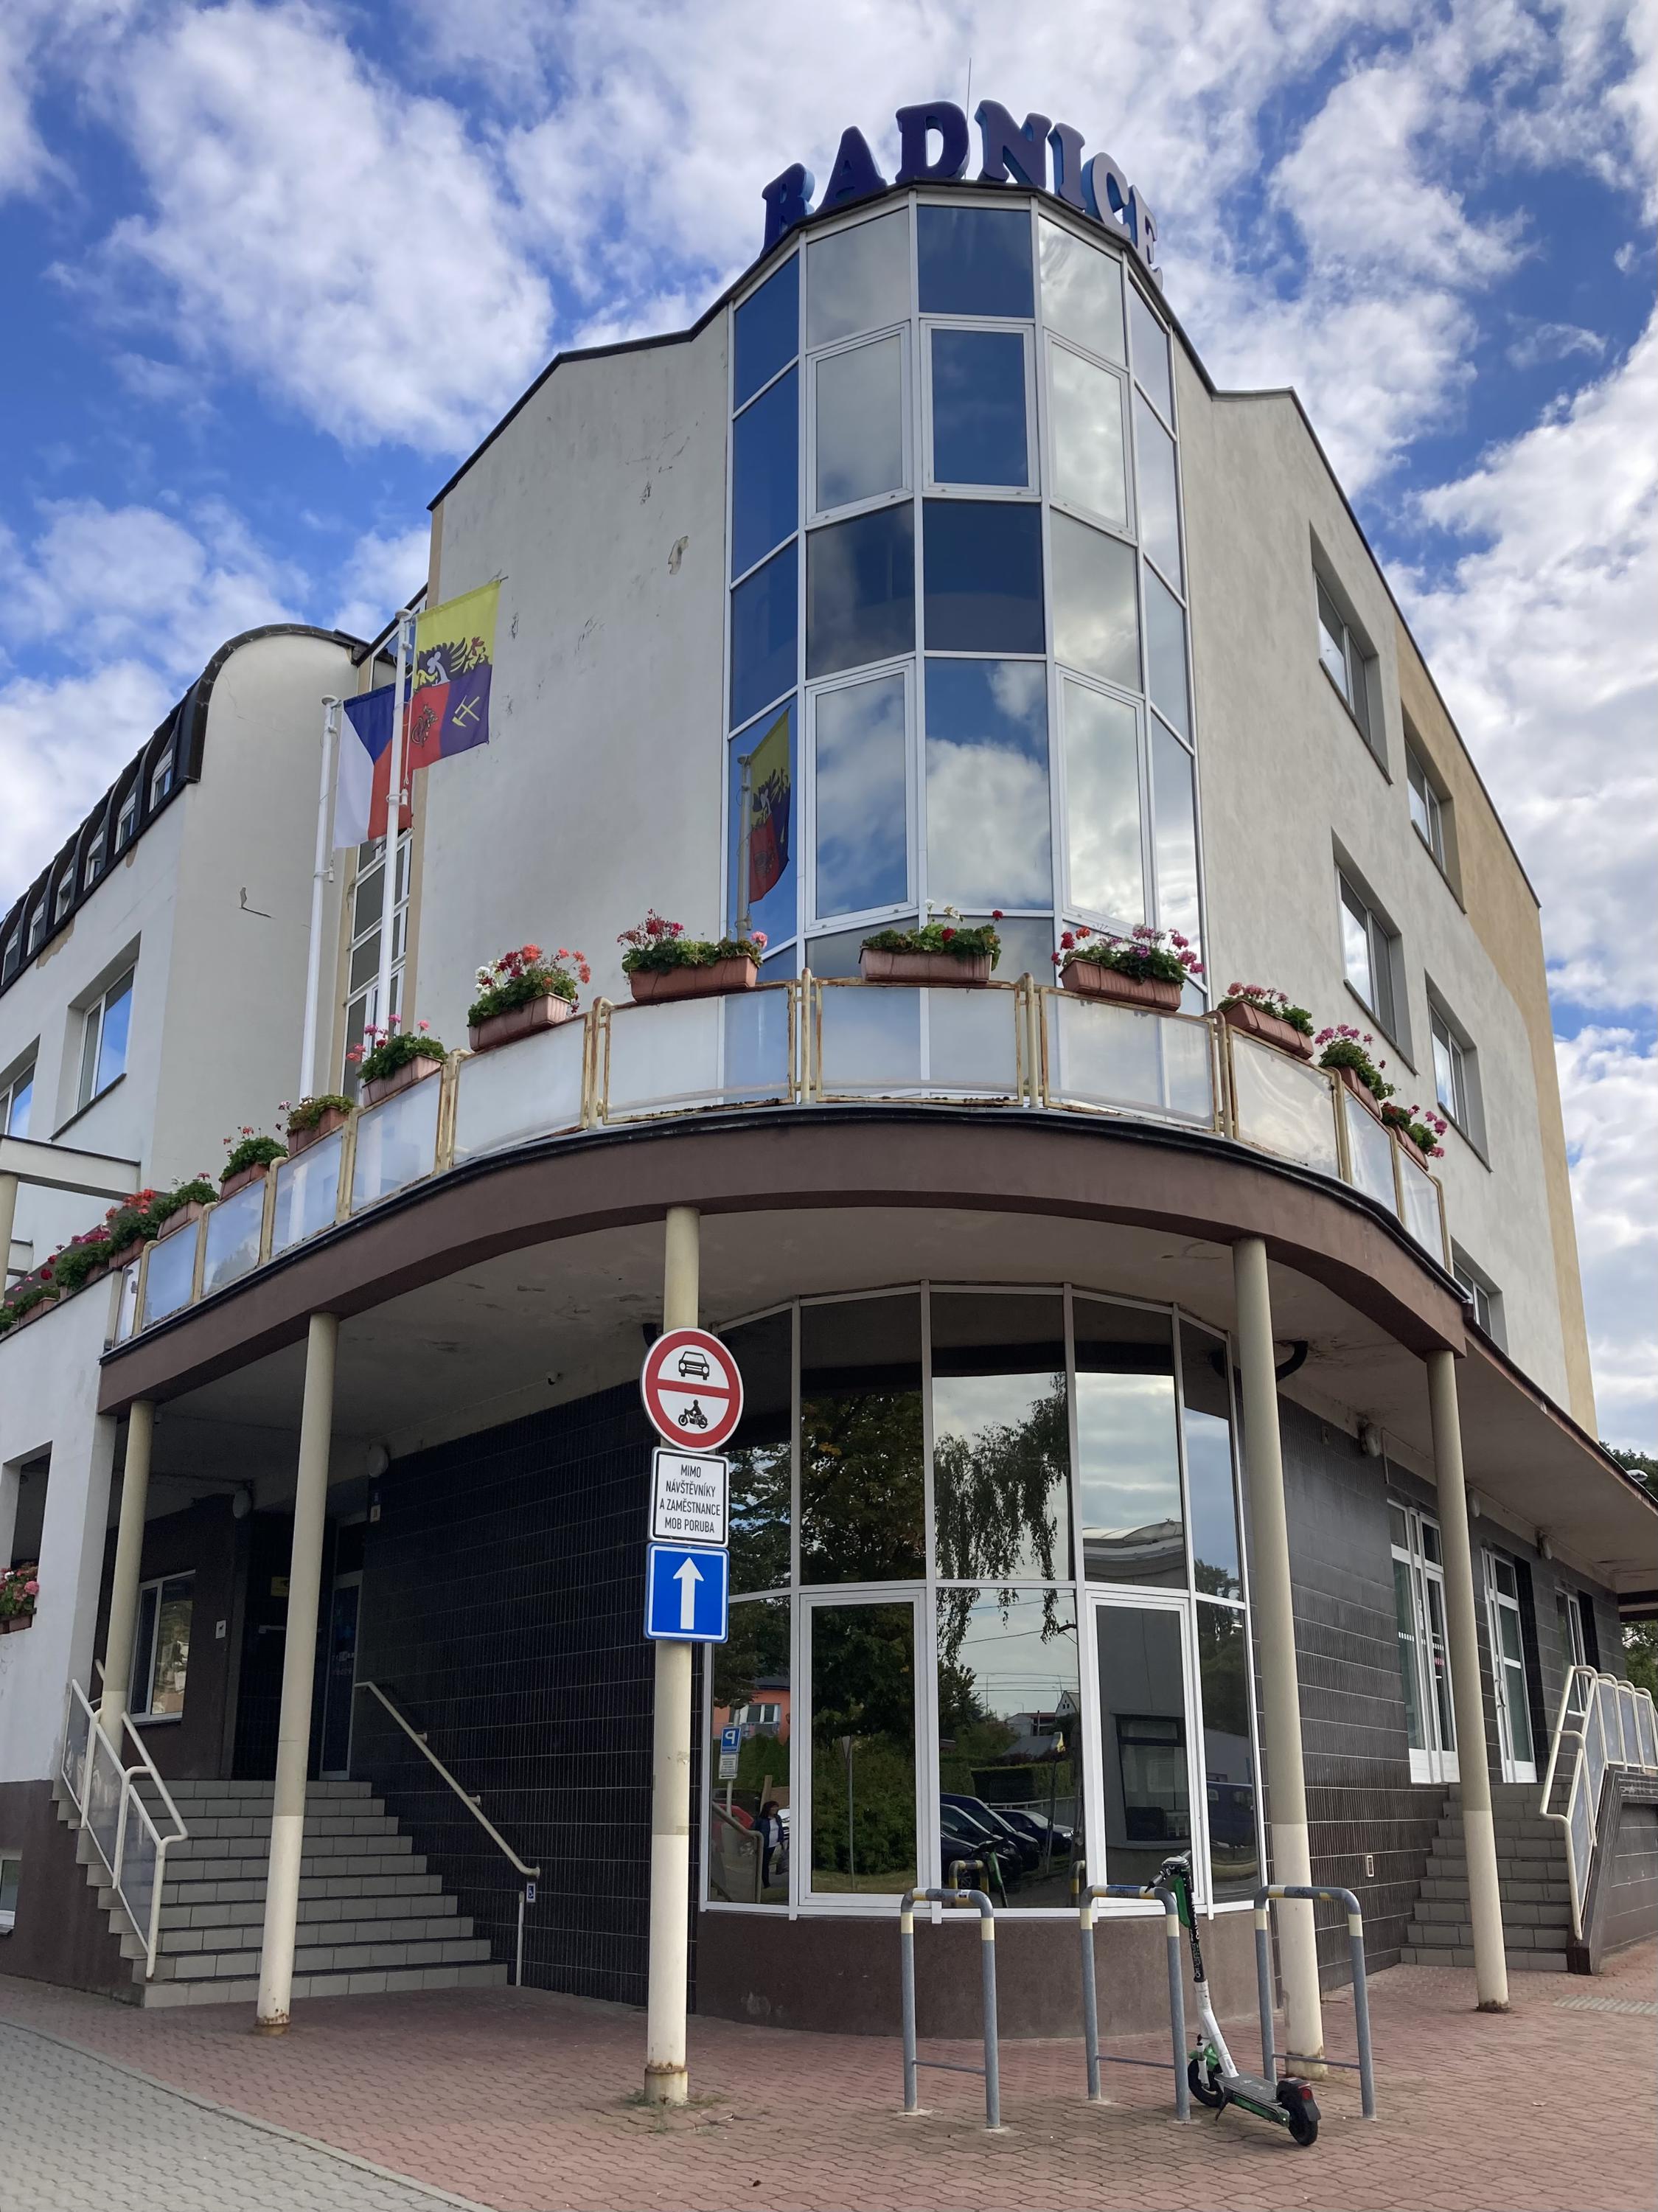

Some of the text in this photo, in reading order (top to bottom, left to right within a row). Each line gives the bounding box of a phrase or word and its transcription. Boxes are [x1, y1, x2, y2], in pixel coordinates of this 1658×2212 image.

[760, 100, 1163, 291] RADNICE
[680, 1464, 701, 1478] MIMO
[666, 1478, 716, 1498] NÁVŠTĚVNÍKY
[659, 1498, 720, 1516] A ZAMĚSTNANCE
[664, 1517, 715, 1533] MOB PORUBA
